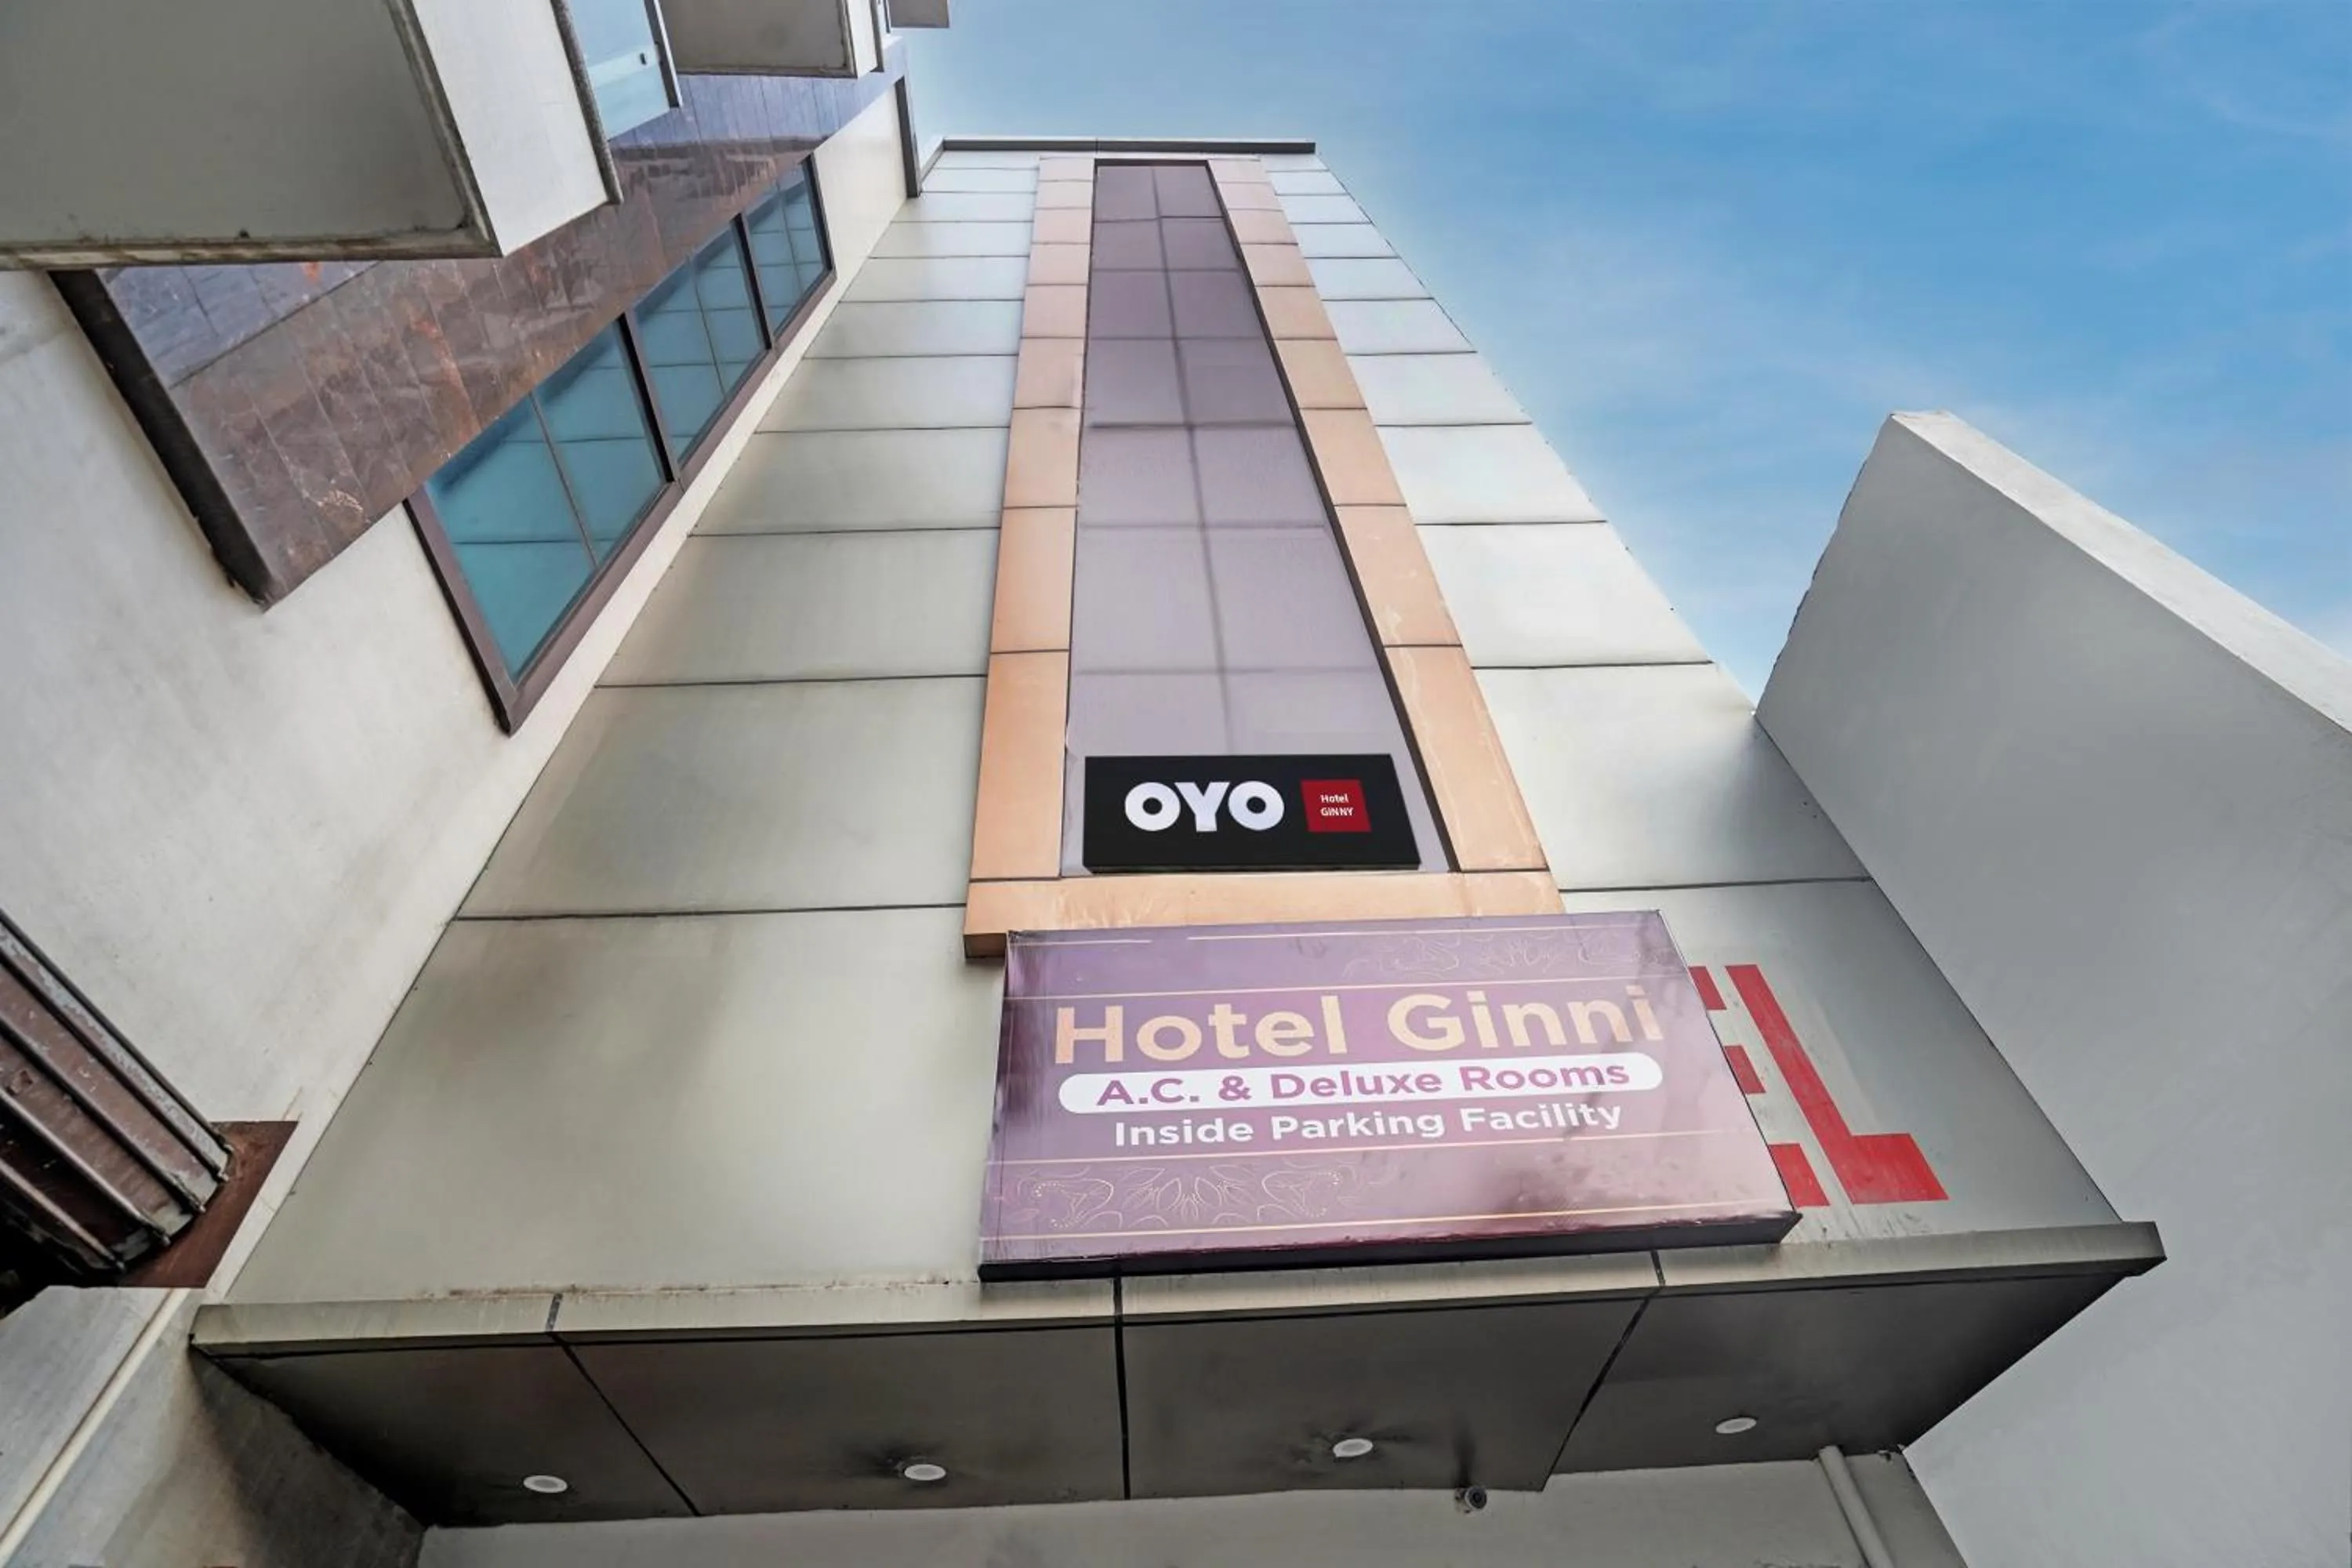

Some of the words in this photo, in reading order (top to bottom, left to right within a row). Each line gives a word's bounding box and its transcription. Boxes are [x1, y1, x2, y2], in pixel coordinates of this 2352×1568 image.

[1124, 780, 1284, 833] OYO
[1320, 793, 1348, 804] Hotel
[1320, 807, 1354, 816] GINNY
[1055, 995, 1348, 1064] Hotel
[1387, 985, 1664, 1052] Ginni
[1097, 1078, 1200, 1106] A.C.
[1218, 1075, 1252, 1102] &
[1271, 1070, 1443, 1099] Deluxe
[1460, 1064, 1630, 1091] Rooms
[1116, 1118, 1253, 1146] Inside
[1271, 1112, 1445, 1140] Parking
[1461, 1102, 1621, 1131] Facility
